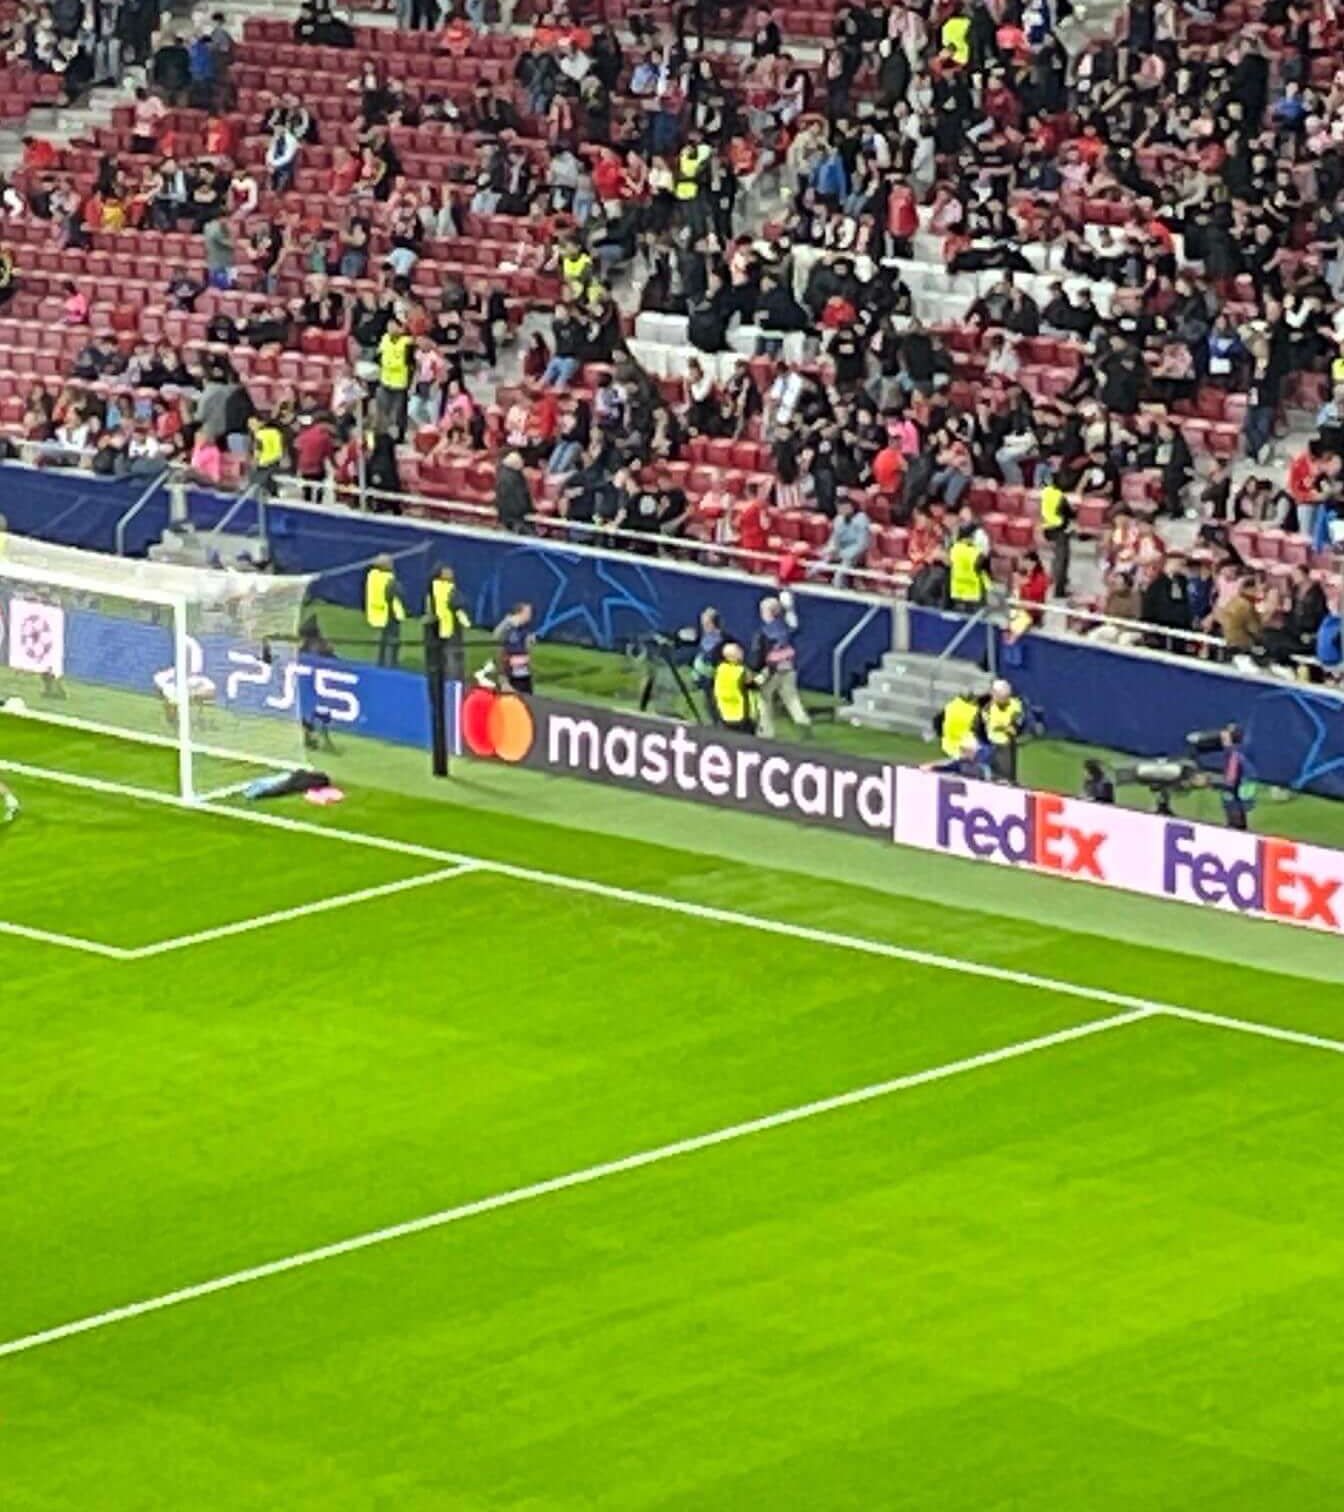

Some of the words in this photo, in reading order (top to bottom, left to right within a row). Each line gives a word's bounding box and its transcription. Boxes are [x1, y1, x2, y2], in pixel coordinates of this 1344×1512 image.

[227, 648, 362, 723] PS5
[548, 715, 893, 829] mastercard
[936, 778, 1107, 880] FedEx
[1164, 821, 1343, 928] FedEx
